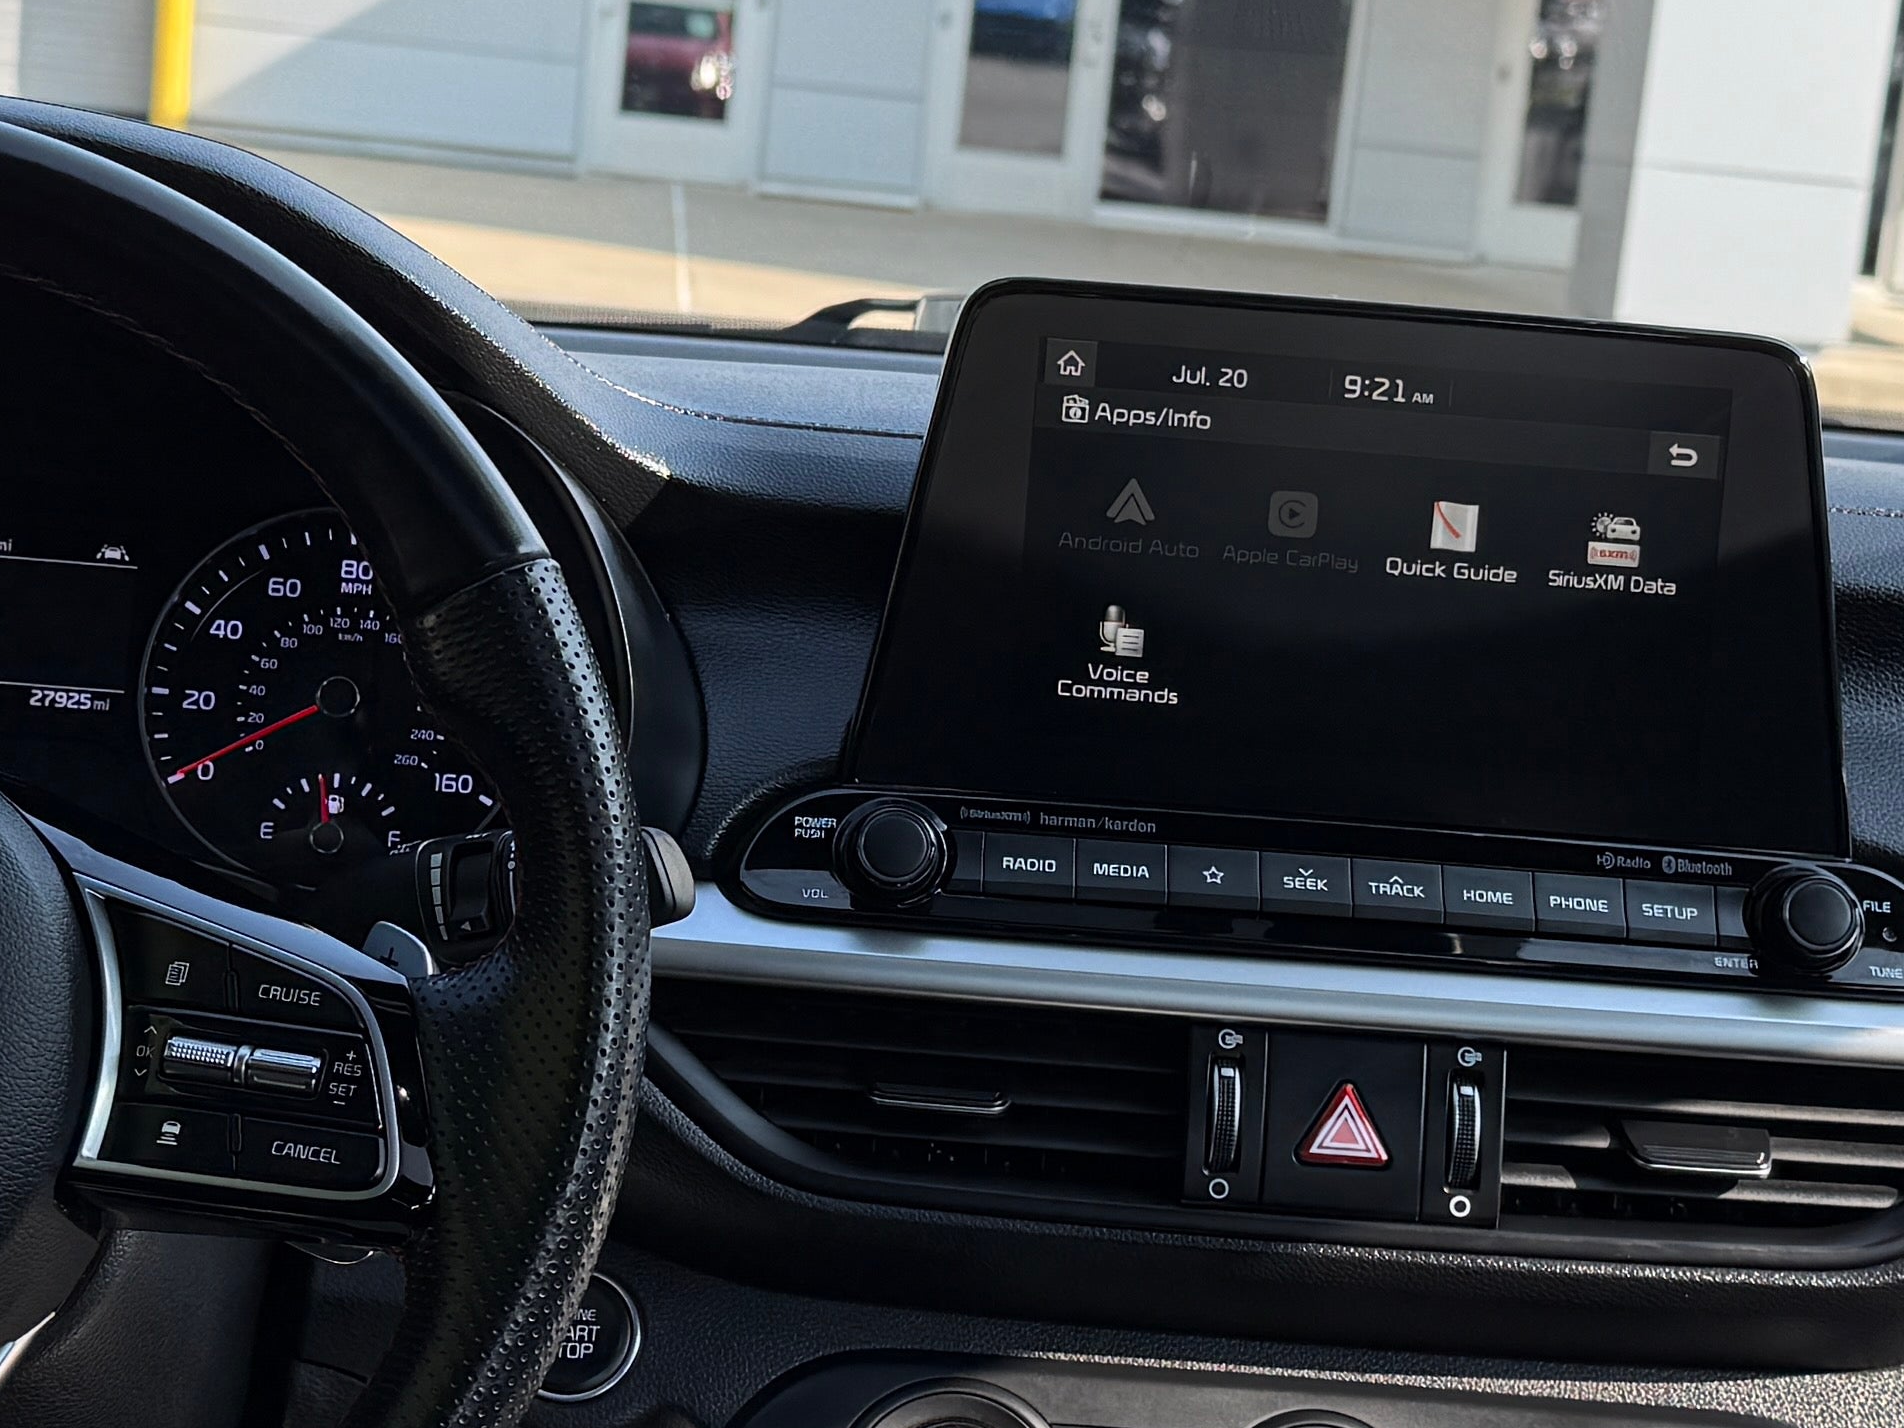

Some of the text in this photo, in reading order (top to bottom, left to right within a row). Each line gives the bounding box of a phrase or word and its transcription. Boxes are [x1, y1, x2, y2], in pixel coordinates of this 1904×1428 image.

[1172, 365, 1248, 388] Jul. 20
[1344, 374, 1434, 405] 9:21 AM
[1095, 402, 1211, 430] Apps/Info
[1059, 532, 1199, 558] Android Auto
[1223, 545, 1359, 573] Apple CarPlay
[340, 560, 373, 580] 80
[1385, 557, 1517, 583] Quick Guide
[267, 578, 301, 598] 60
[340, 582, 372, 596] MPH
[1548, 570, 1676, 595] SiriusXM Data
[209, 620, 242, 640] 40
[302, 624, 323, 635] 100
[329, 618, 350, 629] 120
[359, 619, 380, 631] 140
[260, 658, 278, 670] 60
[1088, 663, 1149, 683] Voice
[248, 685, 266, 697] 40
[1058, 680, 1178, 704] Commands
[182, 690, 215, 710] 20
[247, 713, 264, 724] 20
[197, 760, 214, 781] 0
[435, 773, 473, 794] 160
[260, 822, 274, 839] E
[794, 816, 837, 829] POWER
[1040, 813, 1157, 834] harman/kardon
[388, 831, 401, 847] F
[1003, 857, 1056, 872] RADIO
[1093, 863, 1150, 878] MEDIA
[1617, 856, 1651, 869] Radio
[1677, 858, 1732, 876] Bluetooth
[1283, 875, 1328, 891] SEEK
[1368, 882, 1425, 899] TRACK
[801, 887, 829, 899] VOL
[1463, 889, 1513, 905] HOME
[1549, 896, 1609, 913] PHONE
[1641, 903, 1698, 920] SETUP
[1863, 899, 1891, 914] FILE
[1715, 956, 1758, 969] ENTER
[1869, 966, 1903, 979] TUNE
[258, 984, 321, 1006] CRUISE
[136, 1045, 153, 1058] OK
[333, 1062, 362, 1077] RES
[329, 1083, 356, 1097] SET
[271, 1141, 341, 1165] CANCEL
[565, 1325, 600, 1341] ART
[558, 1343, 594, 1359] TOP
